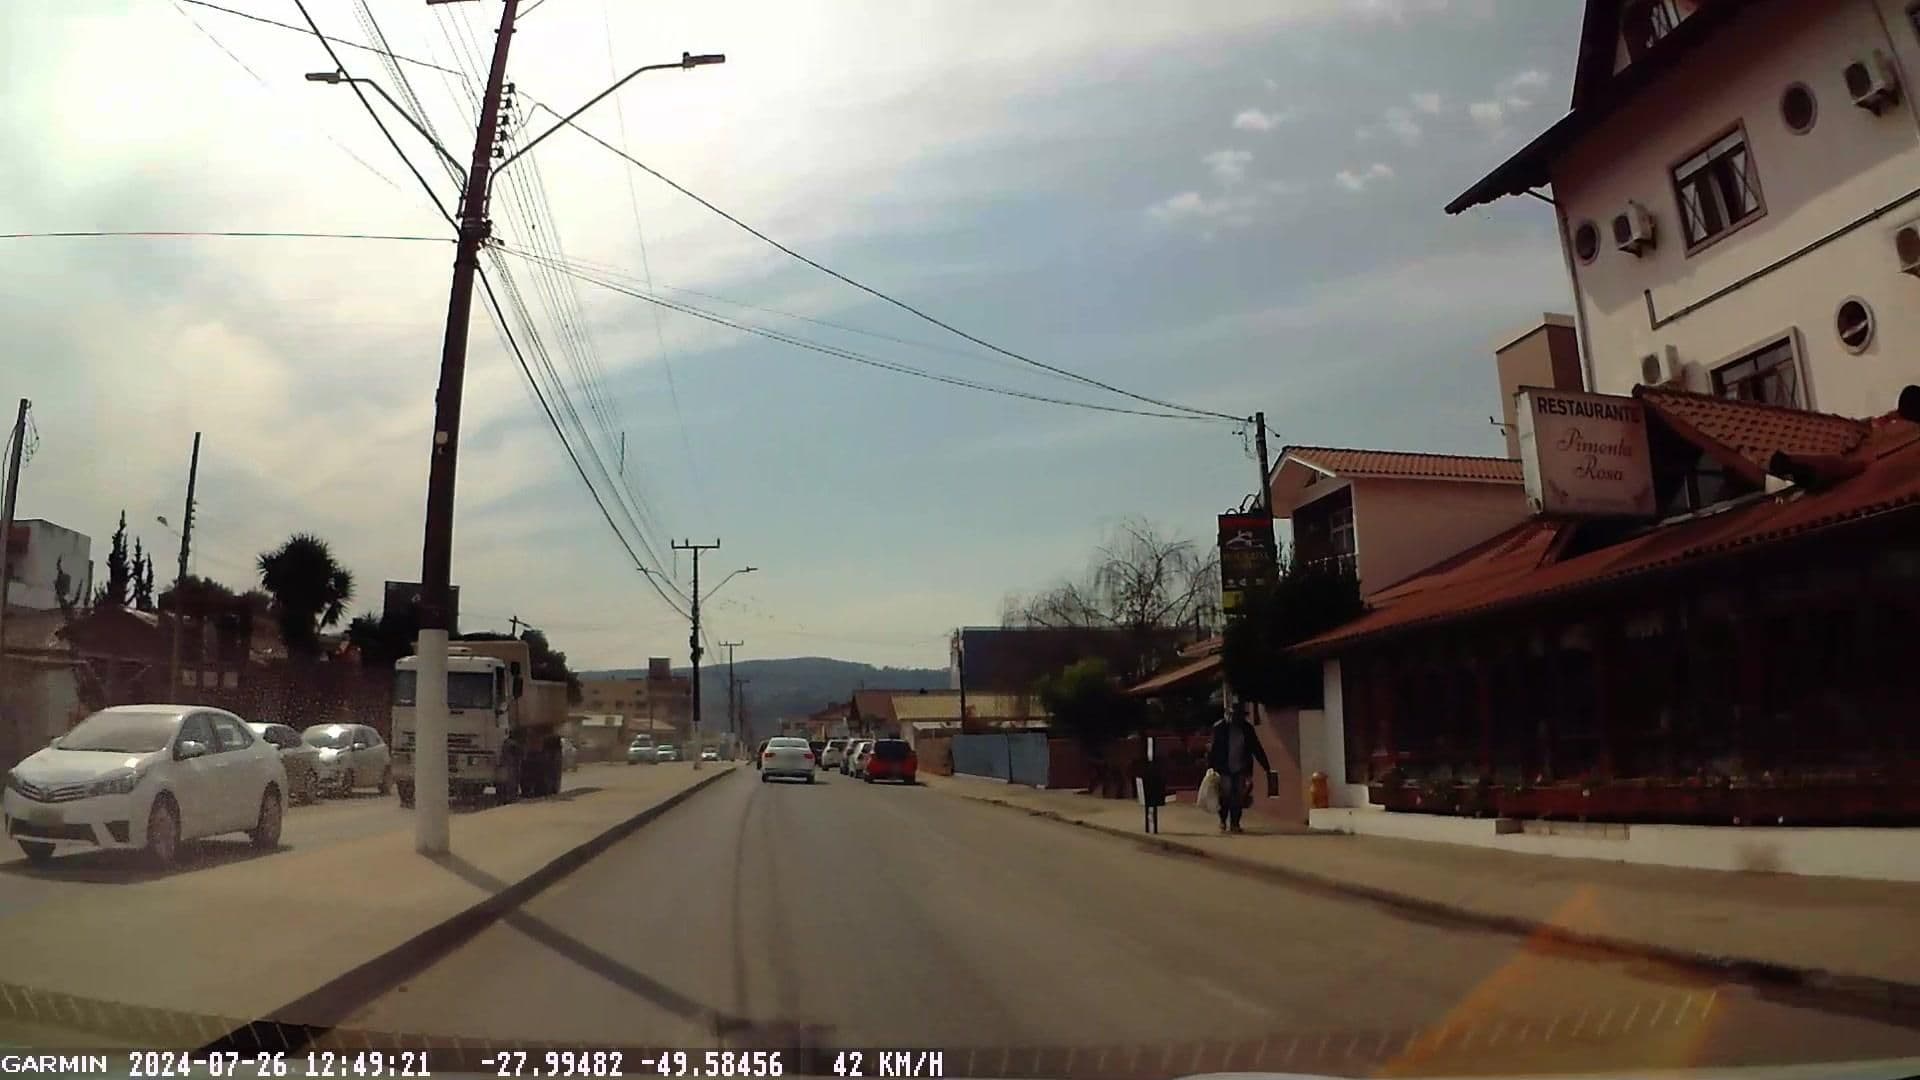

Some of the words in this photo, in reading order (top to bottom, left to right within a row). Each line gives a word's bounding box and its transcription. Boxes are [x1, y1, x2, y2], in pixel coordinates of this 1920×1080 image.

[1537, 396, 1641, 424] RESTAURANTE
[1558, 427, 1633, 457] Pimenta
[1576, 454, 1625, 481] Rosa
